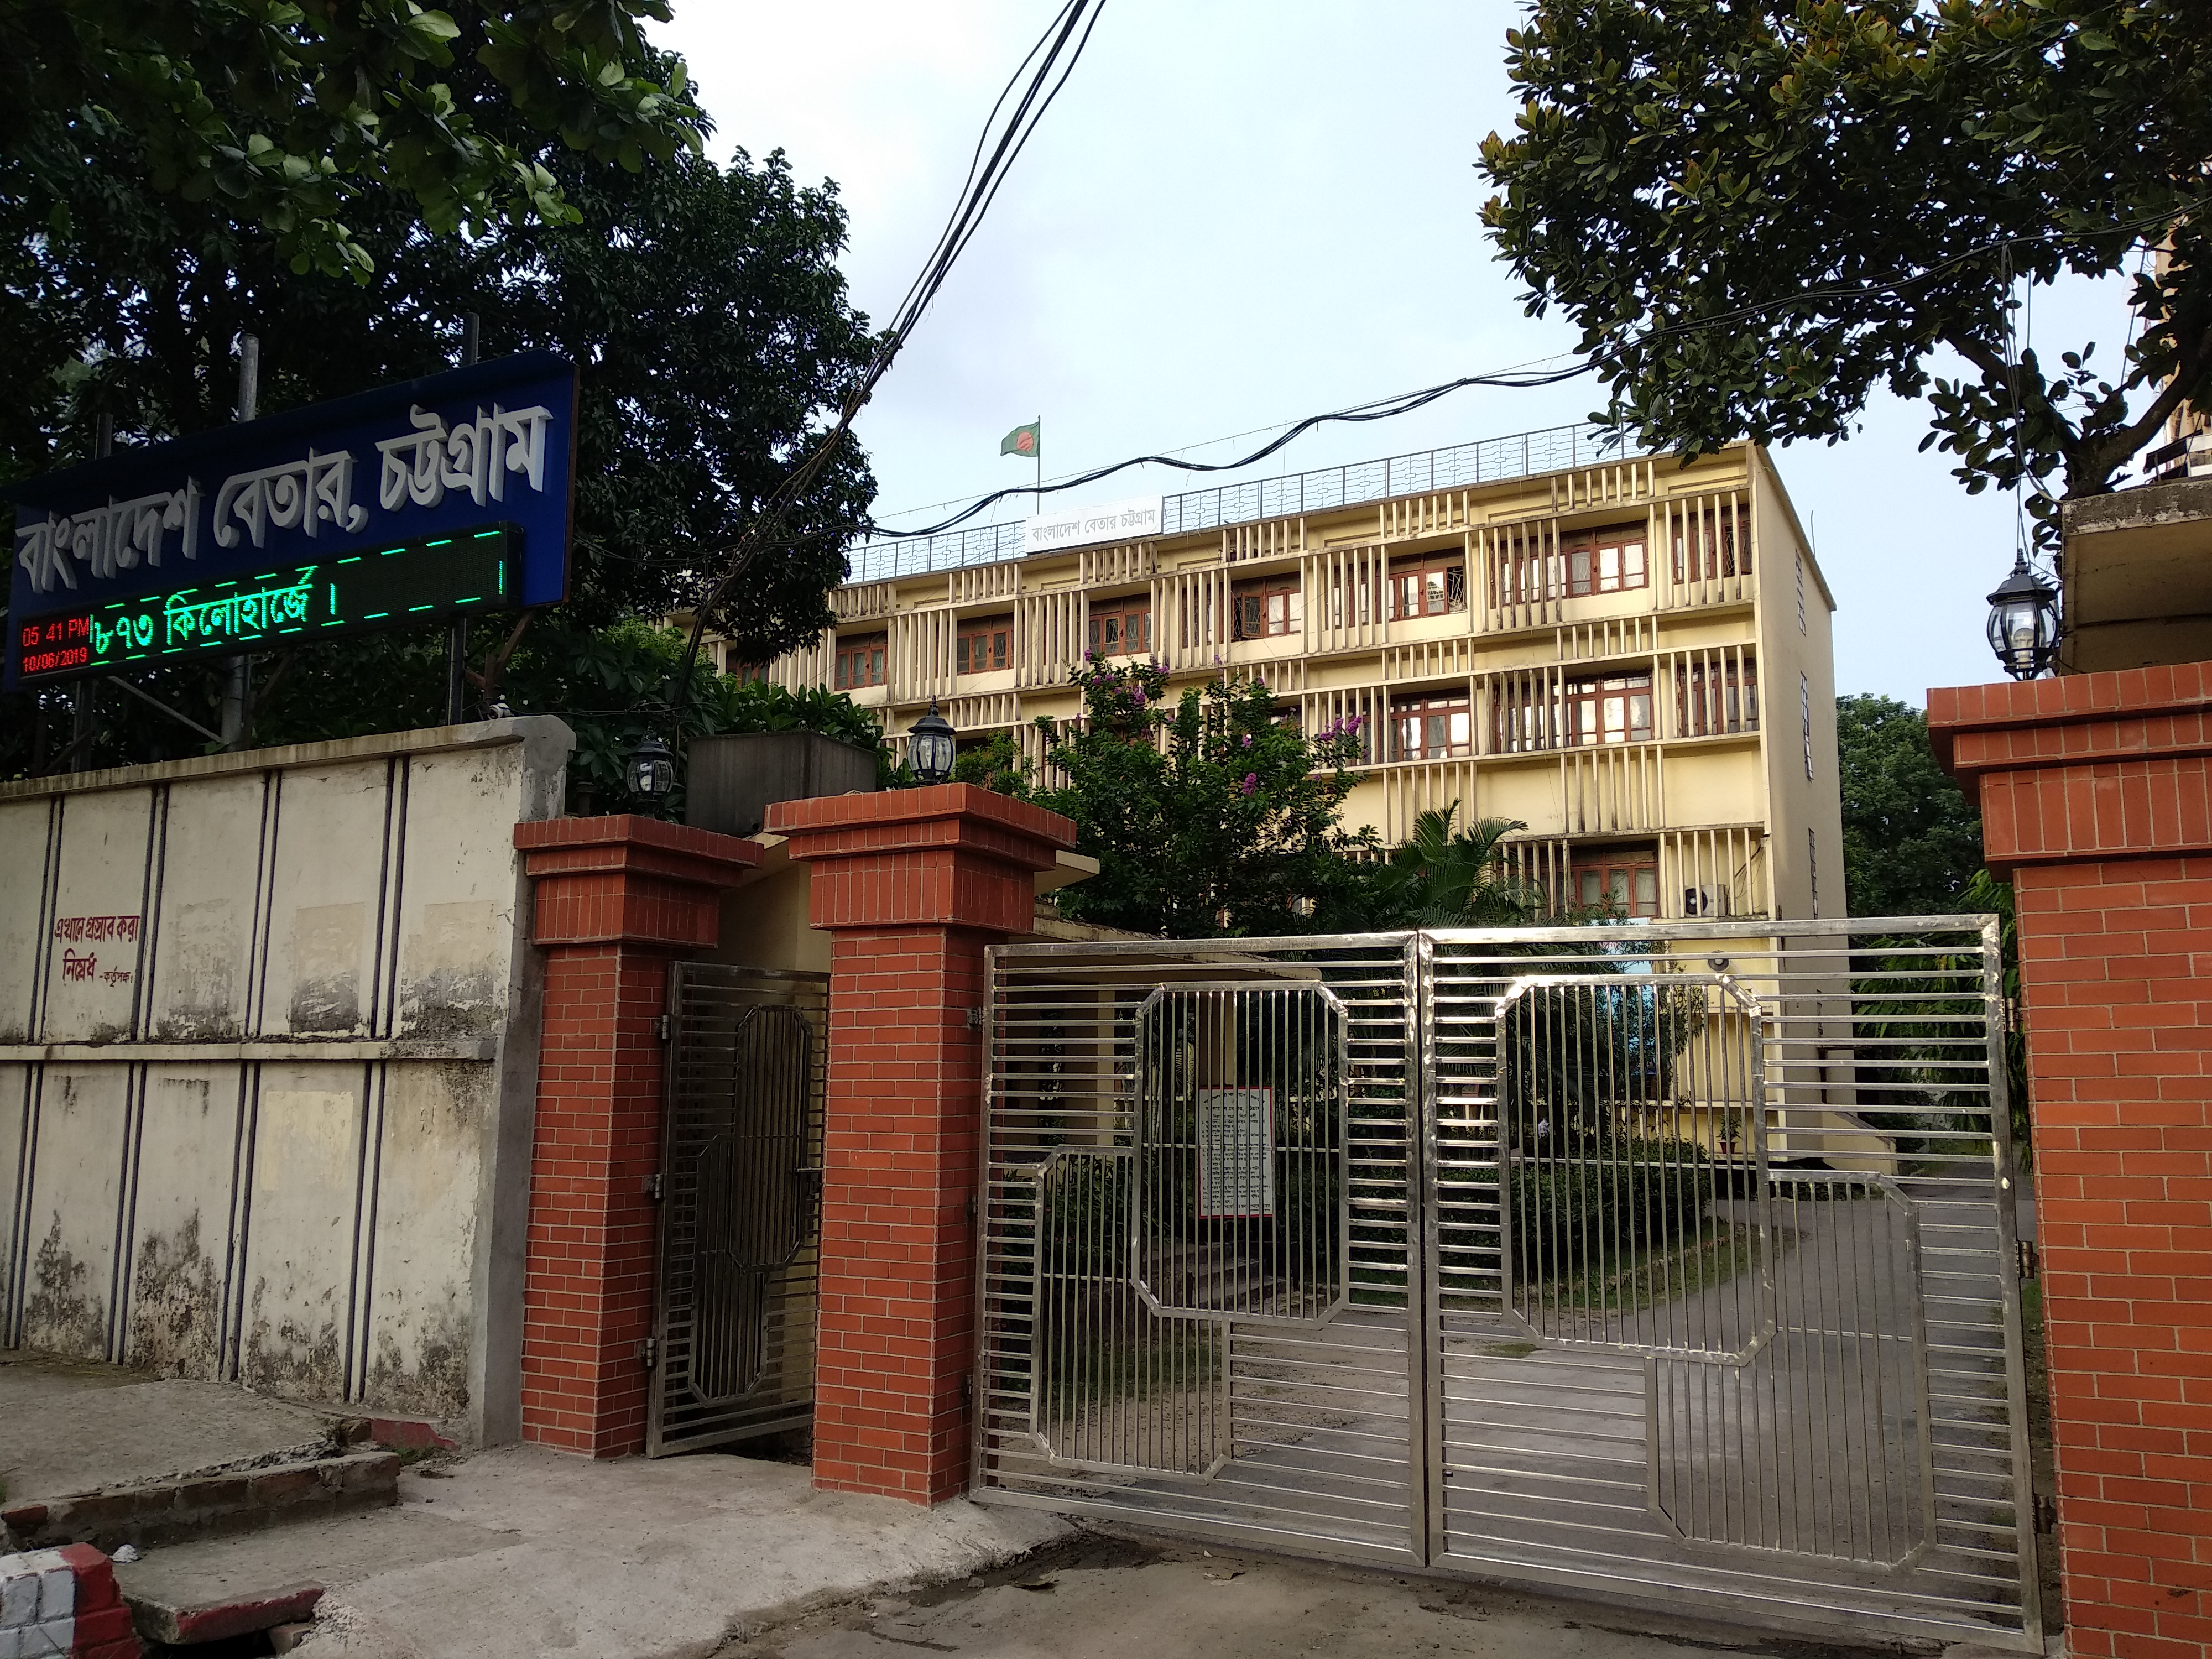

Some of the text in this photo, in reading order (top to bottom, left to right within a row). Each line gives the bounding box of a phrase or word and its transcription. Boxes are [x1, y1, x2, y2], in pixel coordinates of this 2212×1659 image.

[15, 401, 554, 594] বাংলাদেশ বেতার, চট্টগ্রাম
[1032, 508, 1156, 542] বাংলাদেশ বেতার চট্টগ্রাম
[68, 615, 89, 639] PM
[94, 614, 155, 654] ৮৭৩
[23, 646, 87, 672] 10/06/2019
[54, 917, 86, 943] এখানে
[117, 915, 140, 943] করা
[62, 948, 98, 983] নিষেধ
